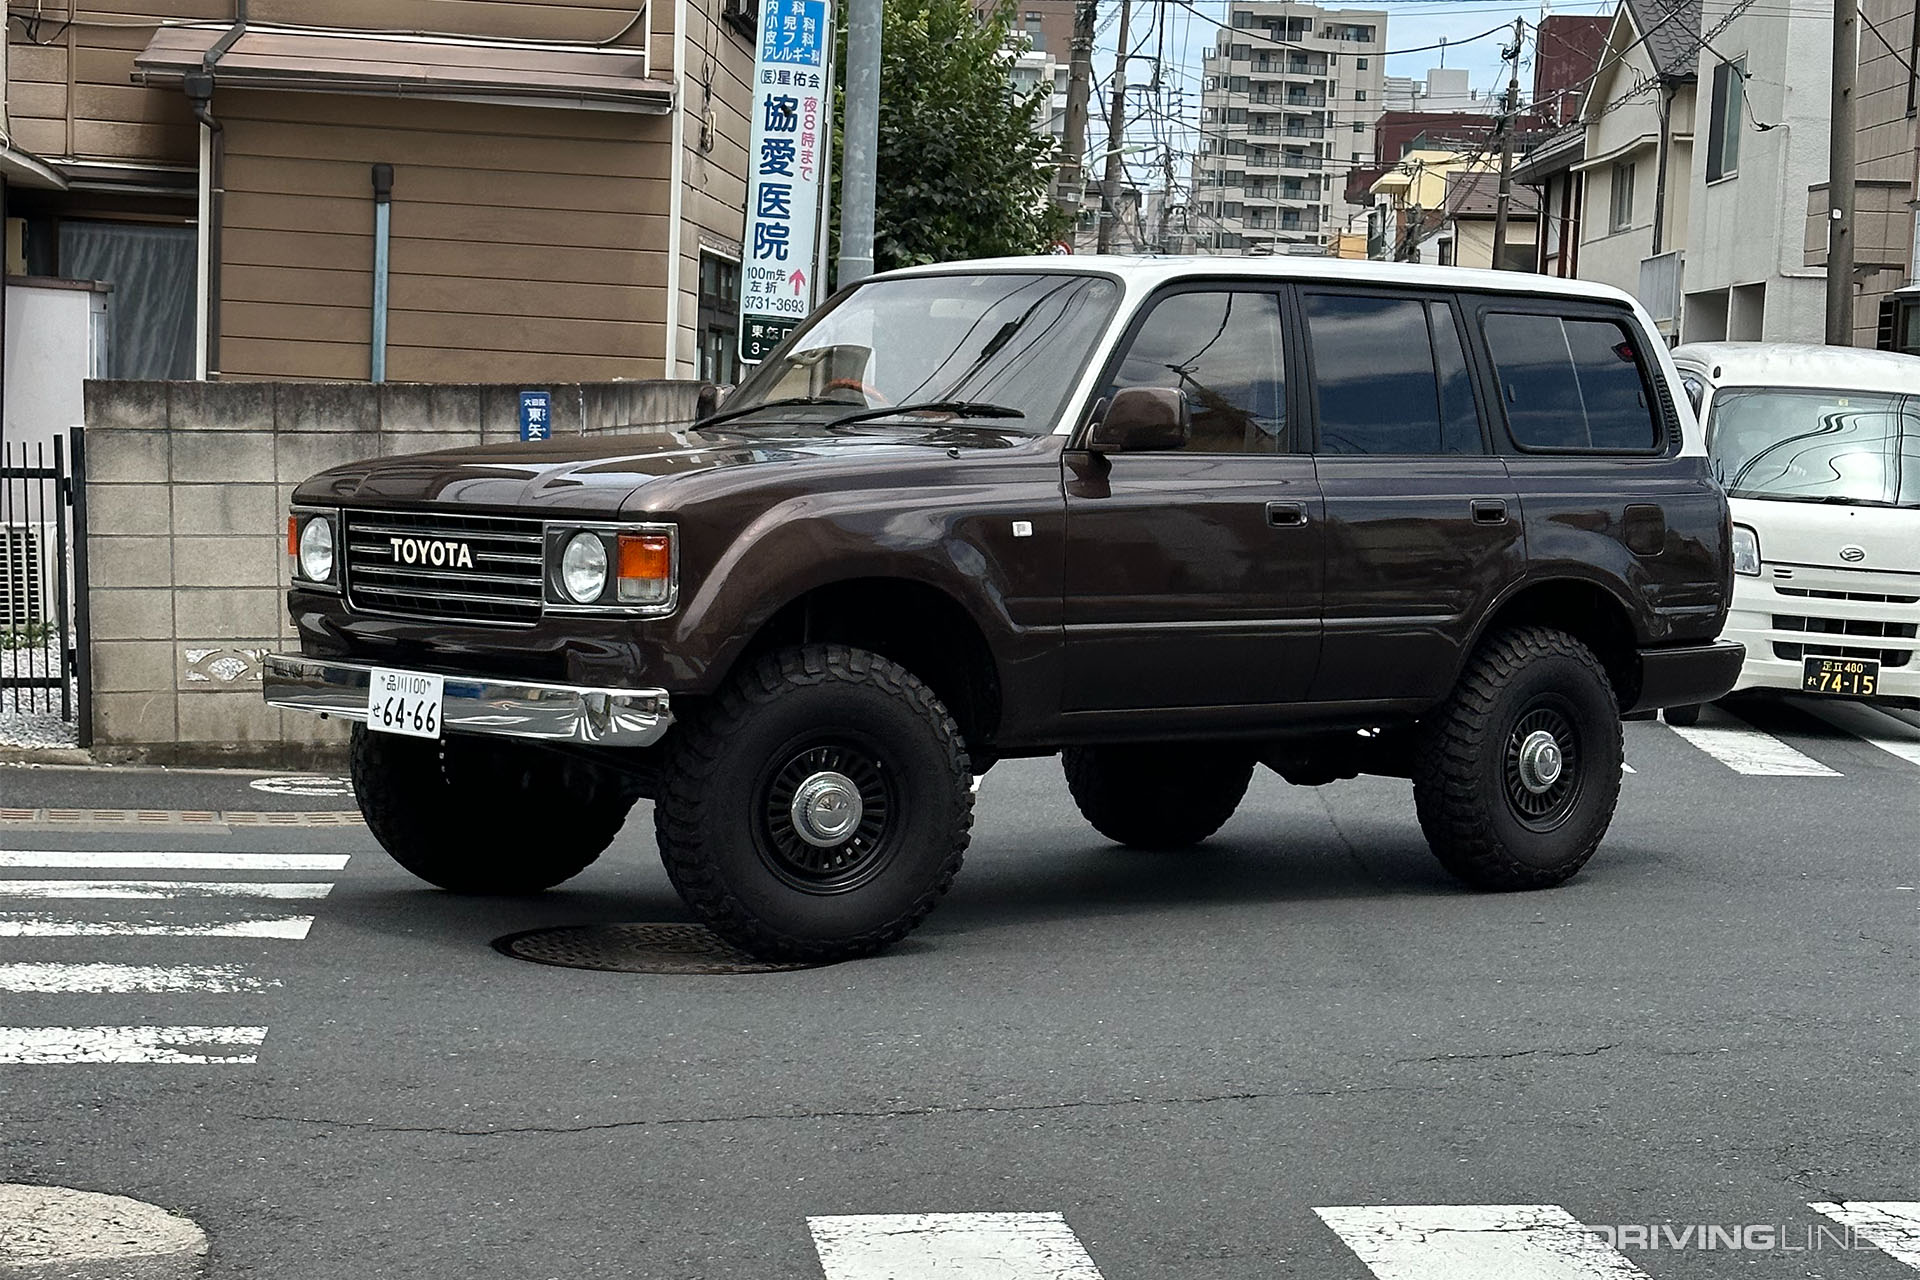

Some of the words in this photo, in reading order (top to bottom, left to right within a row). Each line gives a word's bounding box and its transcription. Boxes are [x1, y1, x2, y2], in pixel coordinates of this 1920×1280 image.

[767, 0, 805, 16] 内科
[766, 15, 816, 32] 小児科
[764, 30, 815, 48] 皮フ科
[763, 46, 820, 65] アレルギー科
[753, 93, 799, 262] 協愛医院
[747, 266, 786, 281] 100m先
[750, 280, 778, 294] 左折
[744, 295, 804, 313] 3731-3693
[390, 537, 473, 568] TOYOTA
